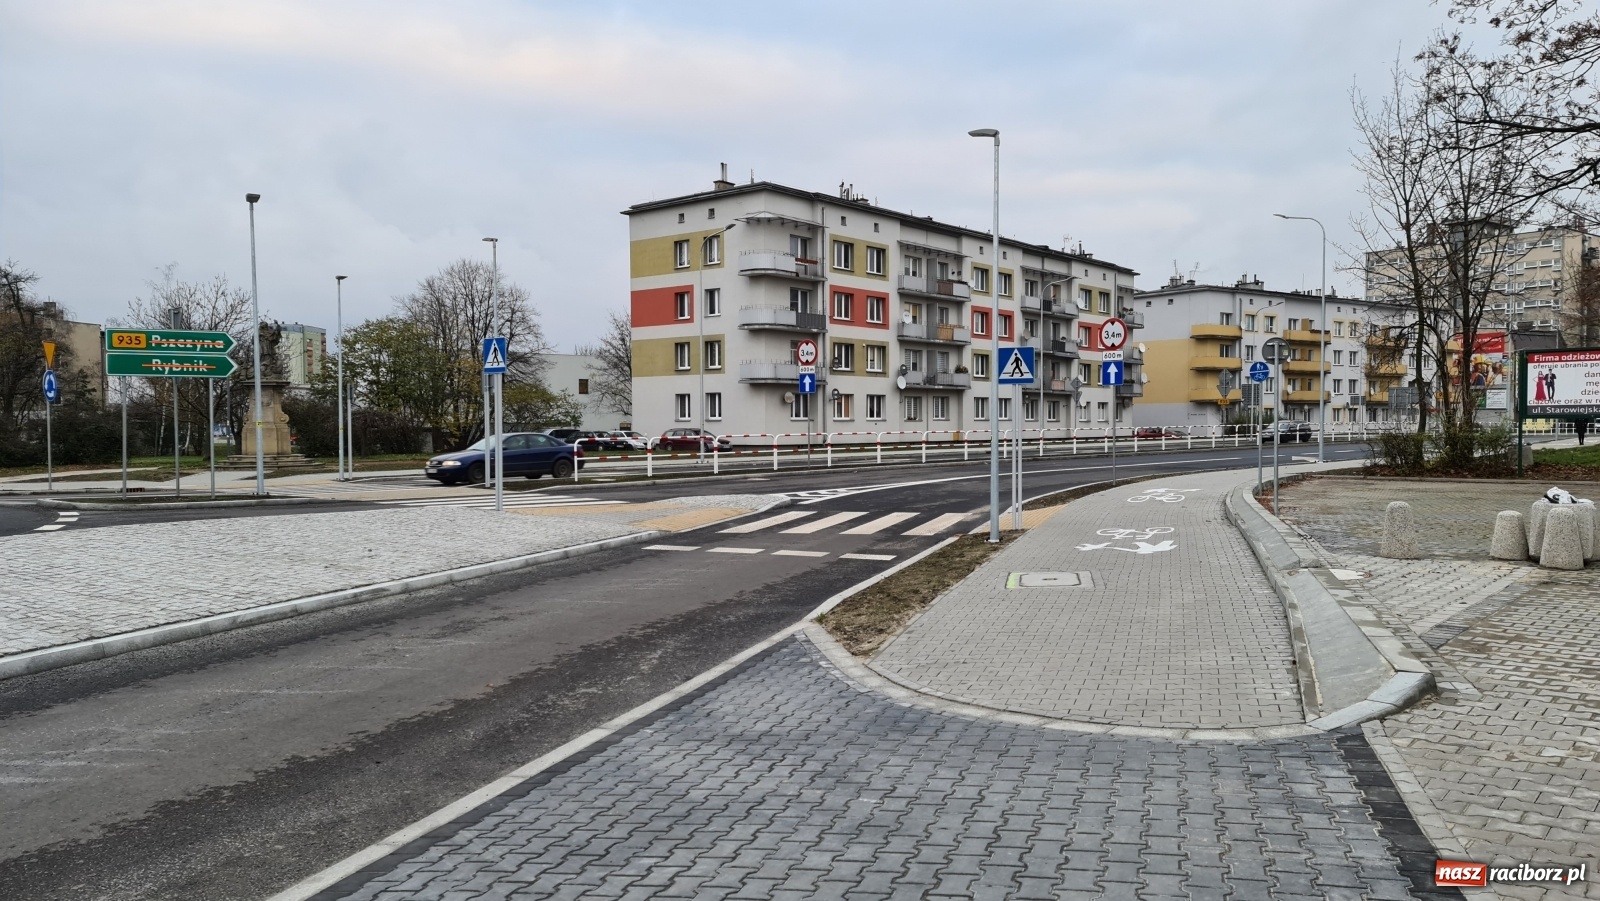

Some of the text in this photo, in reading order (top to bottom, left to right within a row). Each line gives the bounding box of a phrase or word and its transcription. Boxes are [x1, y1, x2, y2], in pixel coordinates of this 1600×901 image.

[117, 334, 225, 351] 935 Pszczyna
[152, 359, 208, 374] Rybnik
